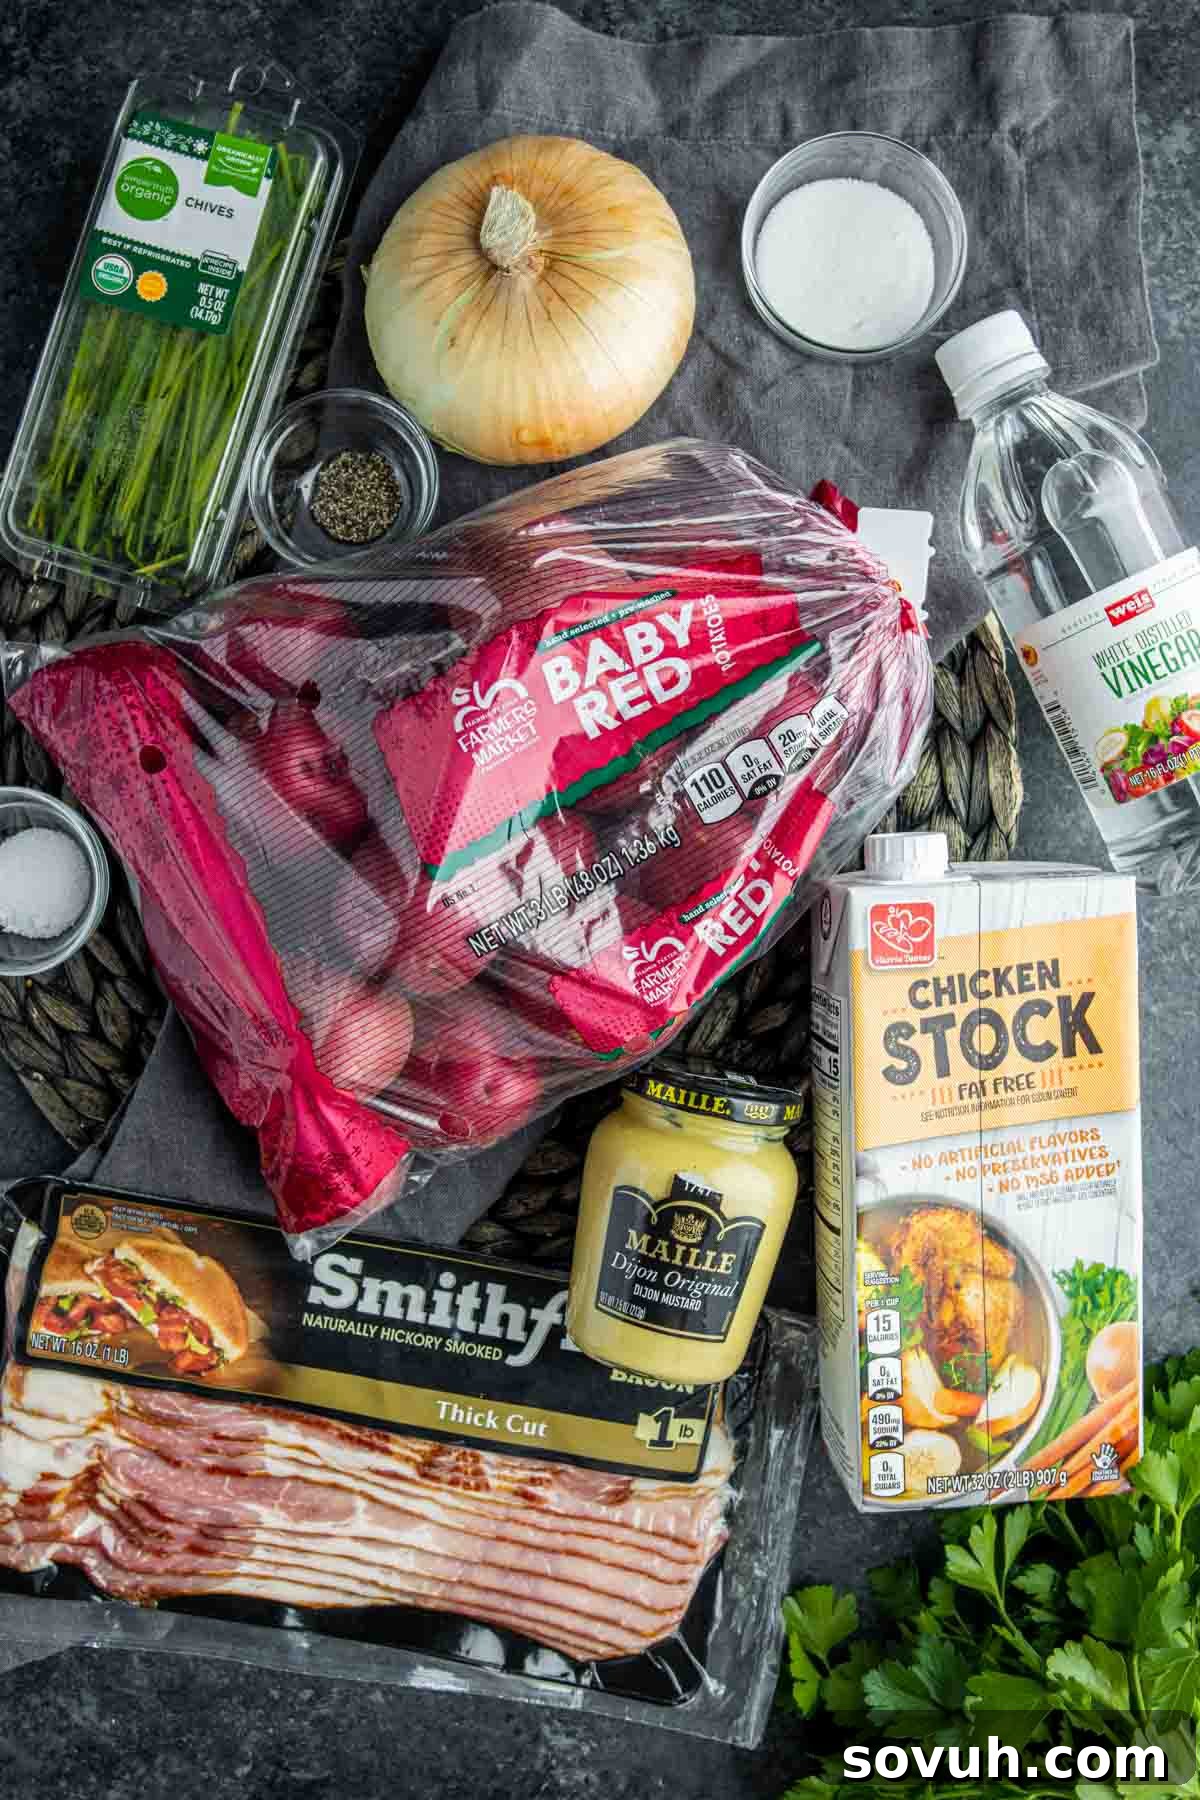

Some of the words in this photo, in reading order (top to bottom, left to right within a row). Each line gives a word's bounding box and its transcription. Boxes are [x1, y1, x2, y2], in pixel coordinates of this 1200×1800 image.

[120, 182, 172, 206] organic
[185, 197, 235, 219] CHIVES
[102, 236, 122, 248] BEST
[123, 243, 131, 251] IF
[132, 246, 192, 268] REFRIGERATED
[198, 282, 215, 297] NET
[215, 287, 230, 300] WT
[200, 296, 213, 309] 0.5
[214, 300, 226, 312] OZ
[544, 631, 569, 648] hand
[570, 614, 610, 637] selected
[618, 590, 672, 618] pre-washed
[701, 593, 736, 673] POTATOES
[541, 601, 695, 706] BABY
[1092, 638, 1135, 670] WHITE
[1135, 610, 1193, 650] DISTILLED
[572, 656, 693, 741] RED
[457, 700, 537, 753] FARMERS
[472, 719, 537, 768] MARKET
[690, 767, 726, 799] 110
[741, 769, 758, 784] SAT
[757, 759, 773, 776] FAT
[767, 778, 777, 791] DV
[697, 785, 736, 814] CALORIES
[468, 925, 506, 958] NET
[504, 911, 534, 940] WT
[531, 900, 547, 922] 3
[544, 885, 570, 912] LB
[568, 869, 595, 902] (48
[591, 852, 624, 887] OZ)
[621, 837, 657, 868] 1.36
[655, 824, 682, 849] kg
[682, 905, 705, 923] hand
[693, 878, 774, 957] RED
[908, 958, 1061, 1010] CHICKEN
[881, 991, 1104, 1086] STOCK
[958, 1080, 986, 1101] FAT
[992, 1072, 1036, 1097] FREE
[920, 1110, 934, 1122] SEE
[935, 1105, 970, 1120] NUTRITION
[971, 1097, 1015, 1113] INFORMATION
[1016, 1094, 1031, 1106] FOR
[911, 1154, 933, 1170] NO
[938, 1137, 1025, 1166] ARTIFICIAL
[1029, 1127, 1101, 1151] FLAVORS
[955, 1167, 978, 1183] NO
[981, 1145, 1109, 1178] PRESERVATIVES
[997, 1179, 1020, 1194] NO
[625, 1229, 736, 1275] MAILLE
[611, 1252, 658, 1280] Dijon
[663, 1271, 739, 1299] Original
[306, 1253, 582, 1367] Smithf
[633, 1284, 660, 1301] DIJON
[660, 1293, 702, 1312] MUSTARD
[886, 1296, 900, 1306] CUP
[302, 1311, 380, 1340] NATURALLY
[380, 1326, 443, 1353] HICKORY
[444, 1337, 503, 1362] SMOKED
[868, 1333, 899, 1344] CALORIES
[873, 1314, 891, 1333] 15
[31, 1333, 48, 1350] NET
[49, 1336, 66, 1353] WT
[71, 1341, 83, 1356] 16
[85, 1343, 98, 1359] OZ
[102, 1346, 111, 1362] (1
[113, 1349, 129, 1366] LB)
[872, 1378, 884, 1388] SAT
[886, 1377, 897, 1386] FAT
[435, 1399, 499, 1431] Thick
[506, 1413, 548, 1439] Cut
[647, 1406, 677, 1449] 1
[679, 1423, 695, 1439] lb
[872, 1425, 899, 1435] SODIUM
[874, 1481, 901, 1490] SUGARS
[878, 1473, 897, 1482] TOTAL
[927, 1476, 950, 1494] NET
[951, 1474, 970, 1493] WT
[971, 1473, 985, 1490] 32
[985, 1472, 1001, 1489] OZ
[1003, 1471, 1016, 1490] (2
[1016, 1469, 1035, 1488] LB)
[1036, 1467, 1057, 1485] 907
[1059, 1471, 1068, 1487] g
